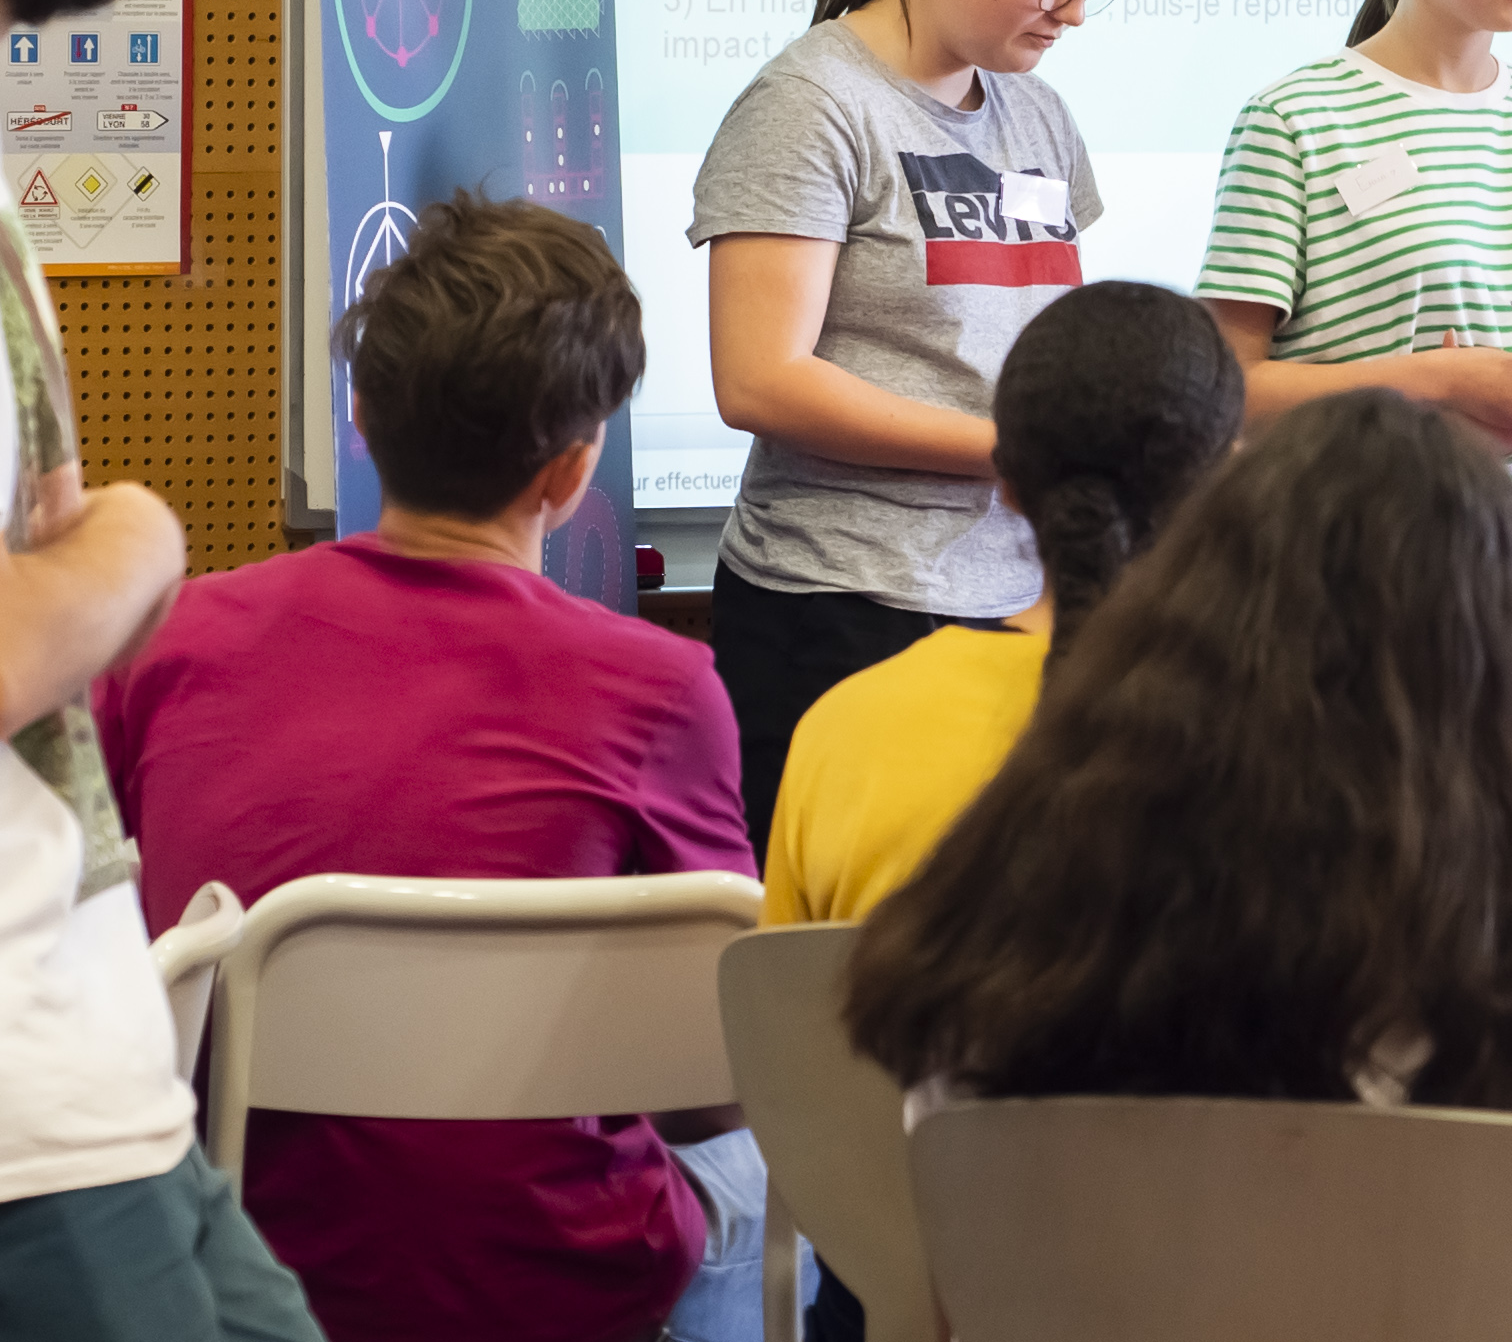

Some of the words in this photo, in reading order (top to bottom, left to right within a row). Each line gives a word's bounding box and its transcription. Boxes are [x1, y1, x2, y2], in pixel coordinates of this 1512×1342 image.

[663, 30, 772, 66] impact
[103, 121, 126, 129] LYON
[654, 471, 740, 492] effectuer
